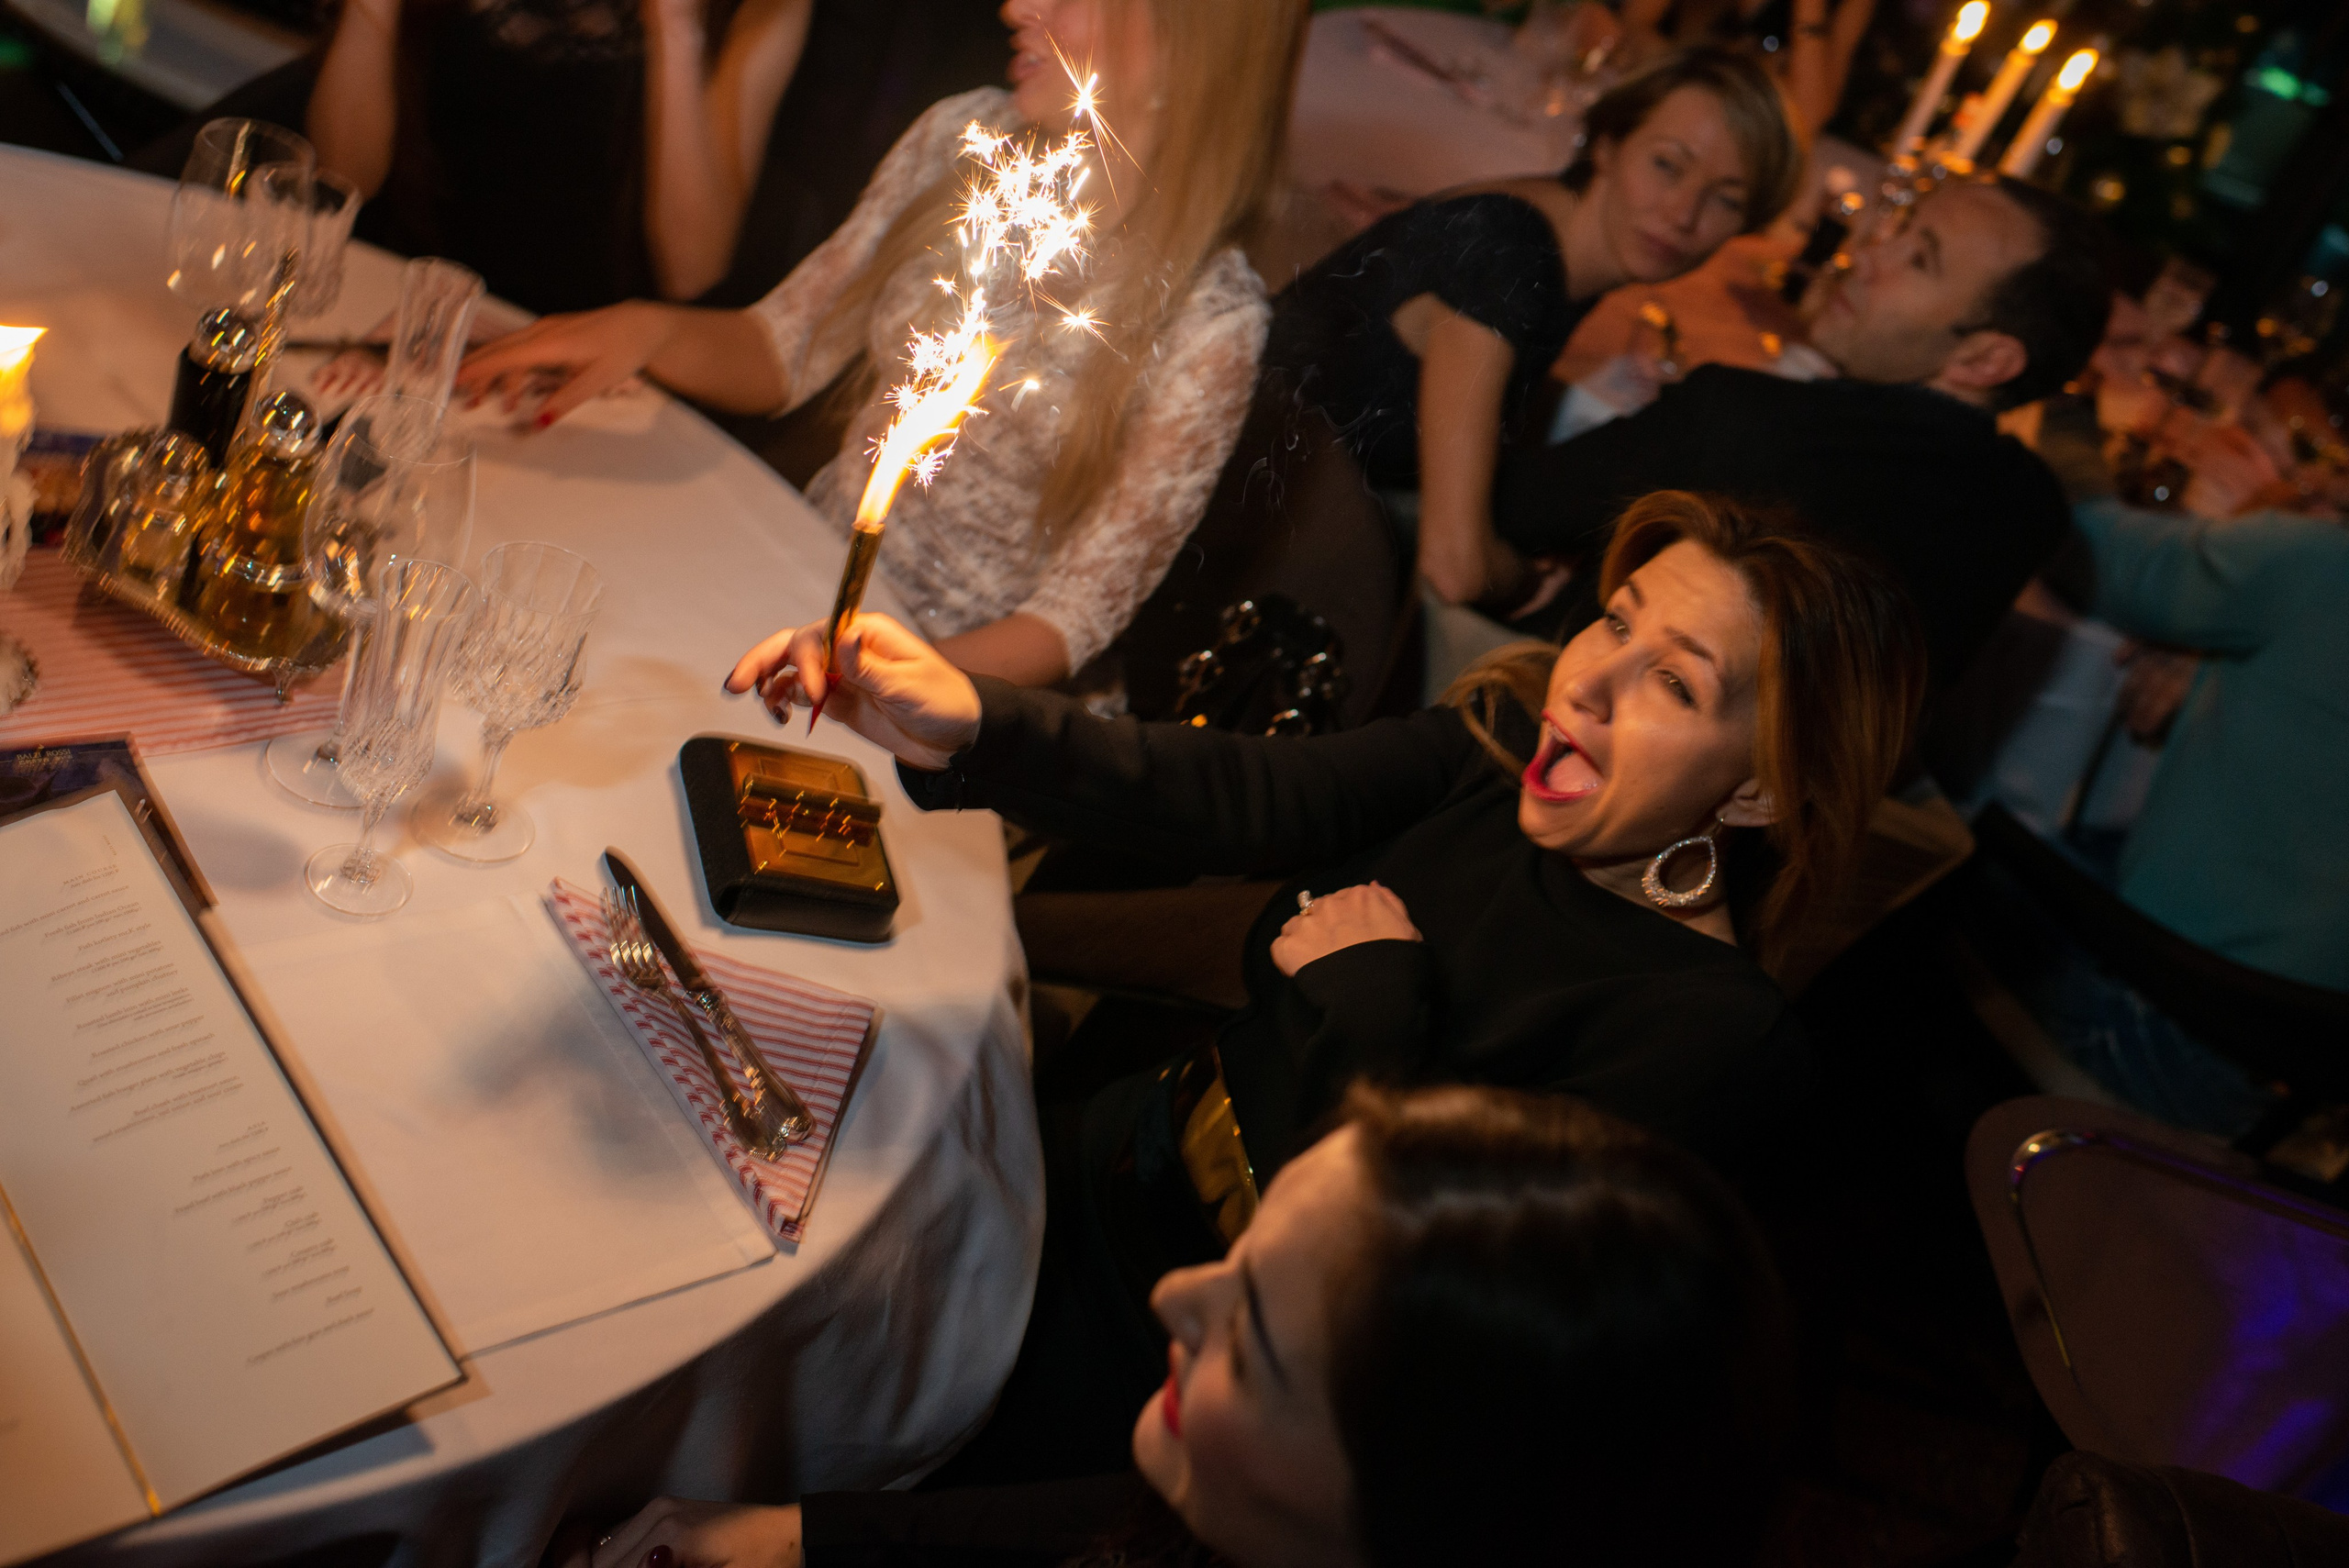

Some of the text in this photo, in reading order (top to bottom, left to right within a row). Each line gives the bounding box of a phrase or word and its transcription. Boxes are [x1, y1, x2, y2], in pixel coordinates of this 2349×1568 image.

[17, 748, 71, 760] BALZI ROSSI
[62, 864, 117, 884] MAIN COURSE
[23, 917, 39, 926] with
[39, 911, 55, 919] mini
[56, 903, 76, 913] carrot
[90, 891, 110, 900] carrot
[112, 884, 129, 893] sauce
[44, 927, 63, 938] Fresh
[77, 917, 94, 925] from
[95, 908, 116, 918] Indian
[117, 901, 138, 911] Ocean
[78, 942, 93, 951] Fish
[94, 934, 117, 945] kotlety
[135, 922, 150, 931] style
[50, 970, 74, 982] Ribeye
[76, 962, 93, 972] steak
[95, 957, 109, 965] with
[127, 940, 161, 955] vegetables
[65, 994, 83, 1003] Fillet
[85, 984, 111, 996] mignon
[113, 977, 128, 985] with
[145, 962, 173, 975] potatoes
[120, 979, 150, 993] pumpkin
[150, 969, 178, 982] chutney
[75, 1016, 104, 1029] Roasted
[105, 1009, 122, 1018] lamb
[138, 998, 153, 1006] with
[91, 1044, 120, 1057] Roasted
[121, 1035, 148, 1047] chicken
[148, 1029, 163, 1037] with
[181, 1016, 205, 1027] pepper
[98, 1068, 115, 1077] with
[115, 1054, 156, 1072] mushrooms
[158, 1048, 170, 1056] and
[171, 1042, 187, 1051] fresh
[189, 1032, 215, 1045] spinach
[102, 1090, 115, 1098] fish
[139, 1074, 157, 1085] plate
[158, 1069, 173, 1077] with
[175, 1058, 206, 1073] vegetable
[206, 1051, 226, 1061] chips
[172, 1093, 187, 1101] with
[193, 1095, 206, 1104] and
[206, 1090, 221, 1098] sour
[223, 1083, 243, 1093] cream
[225, 1159, 241, 1168] with
